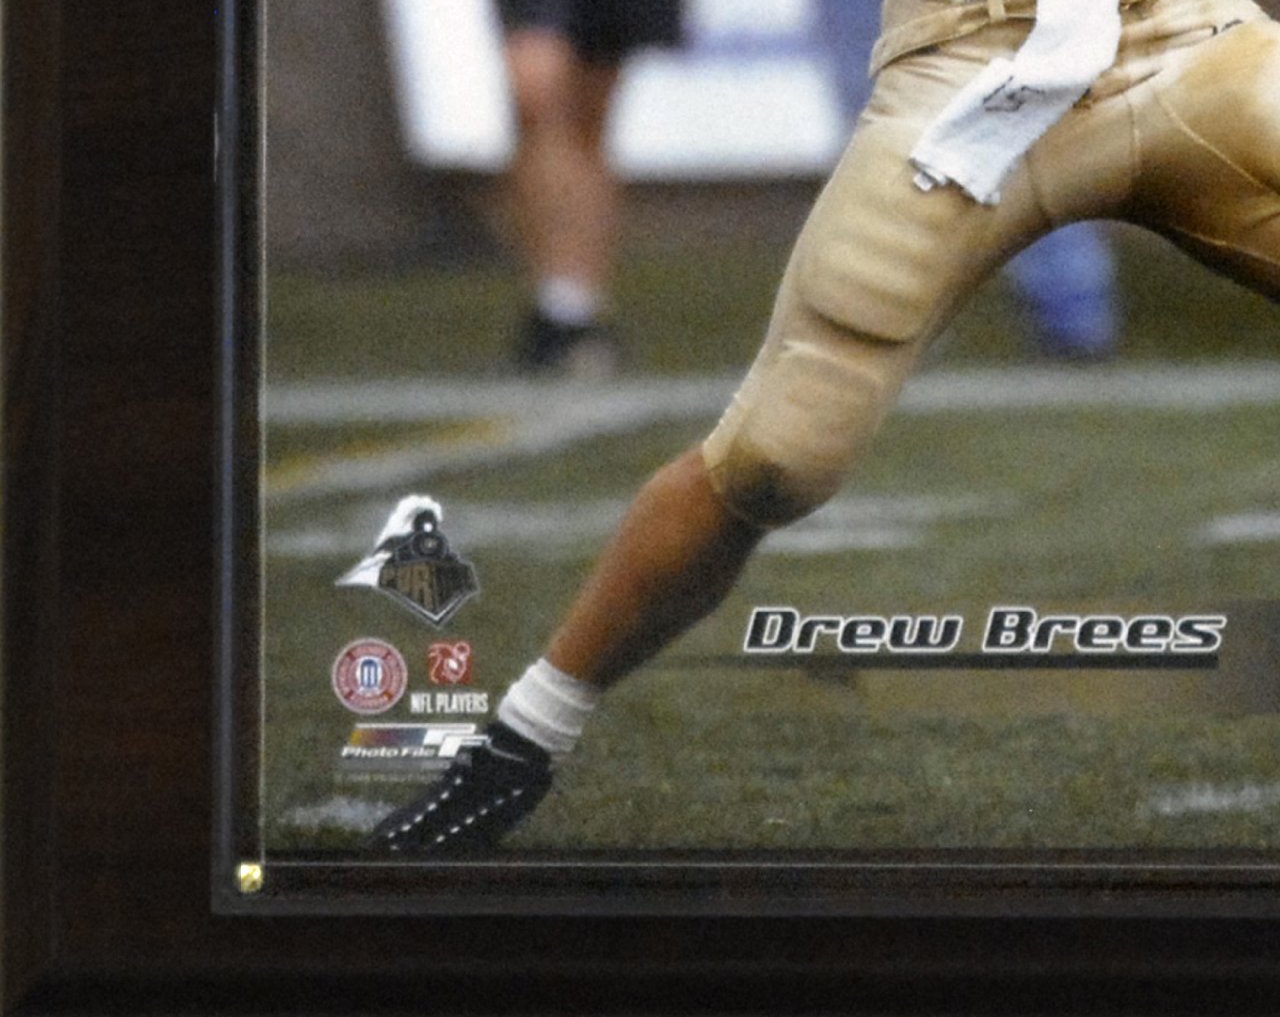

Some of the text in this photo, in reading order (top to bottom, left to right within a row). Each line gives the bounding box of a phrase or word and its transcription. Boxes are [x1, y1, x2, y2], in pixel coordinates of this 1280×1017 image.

[743, 607, 1226, 653] Drew Brees
[410, 692, 489, 713] NFL PLAYERS
[341, 746, 435, 757] Photo File
